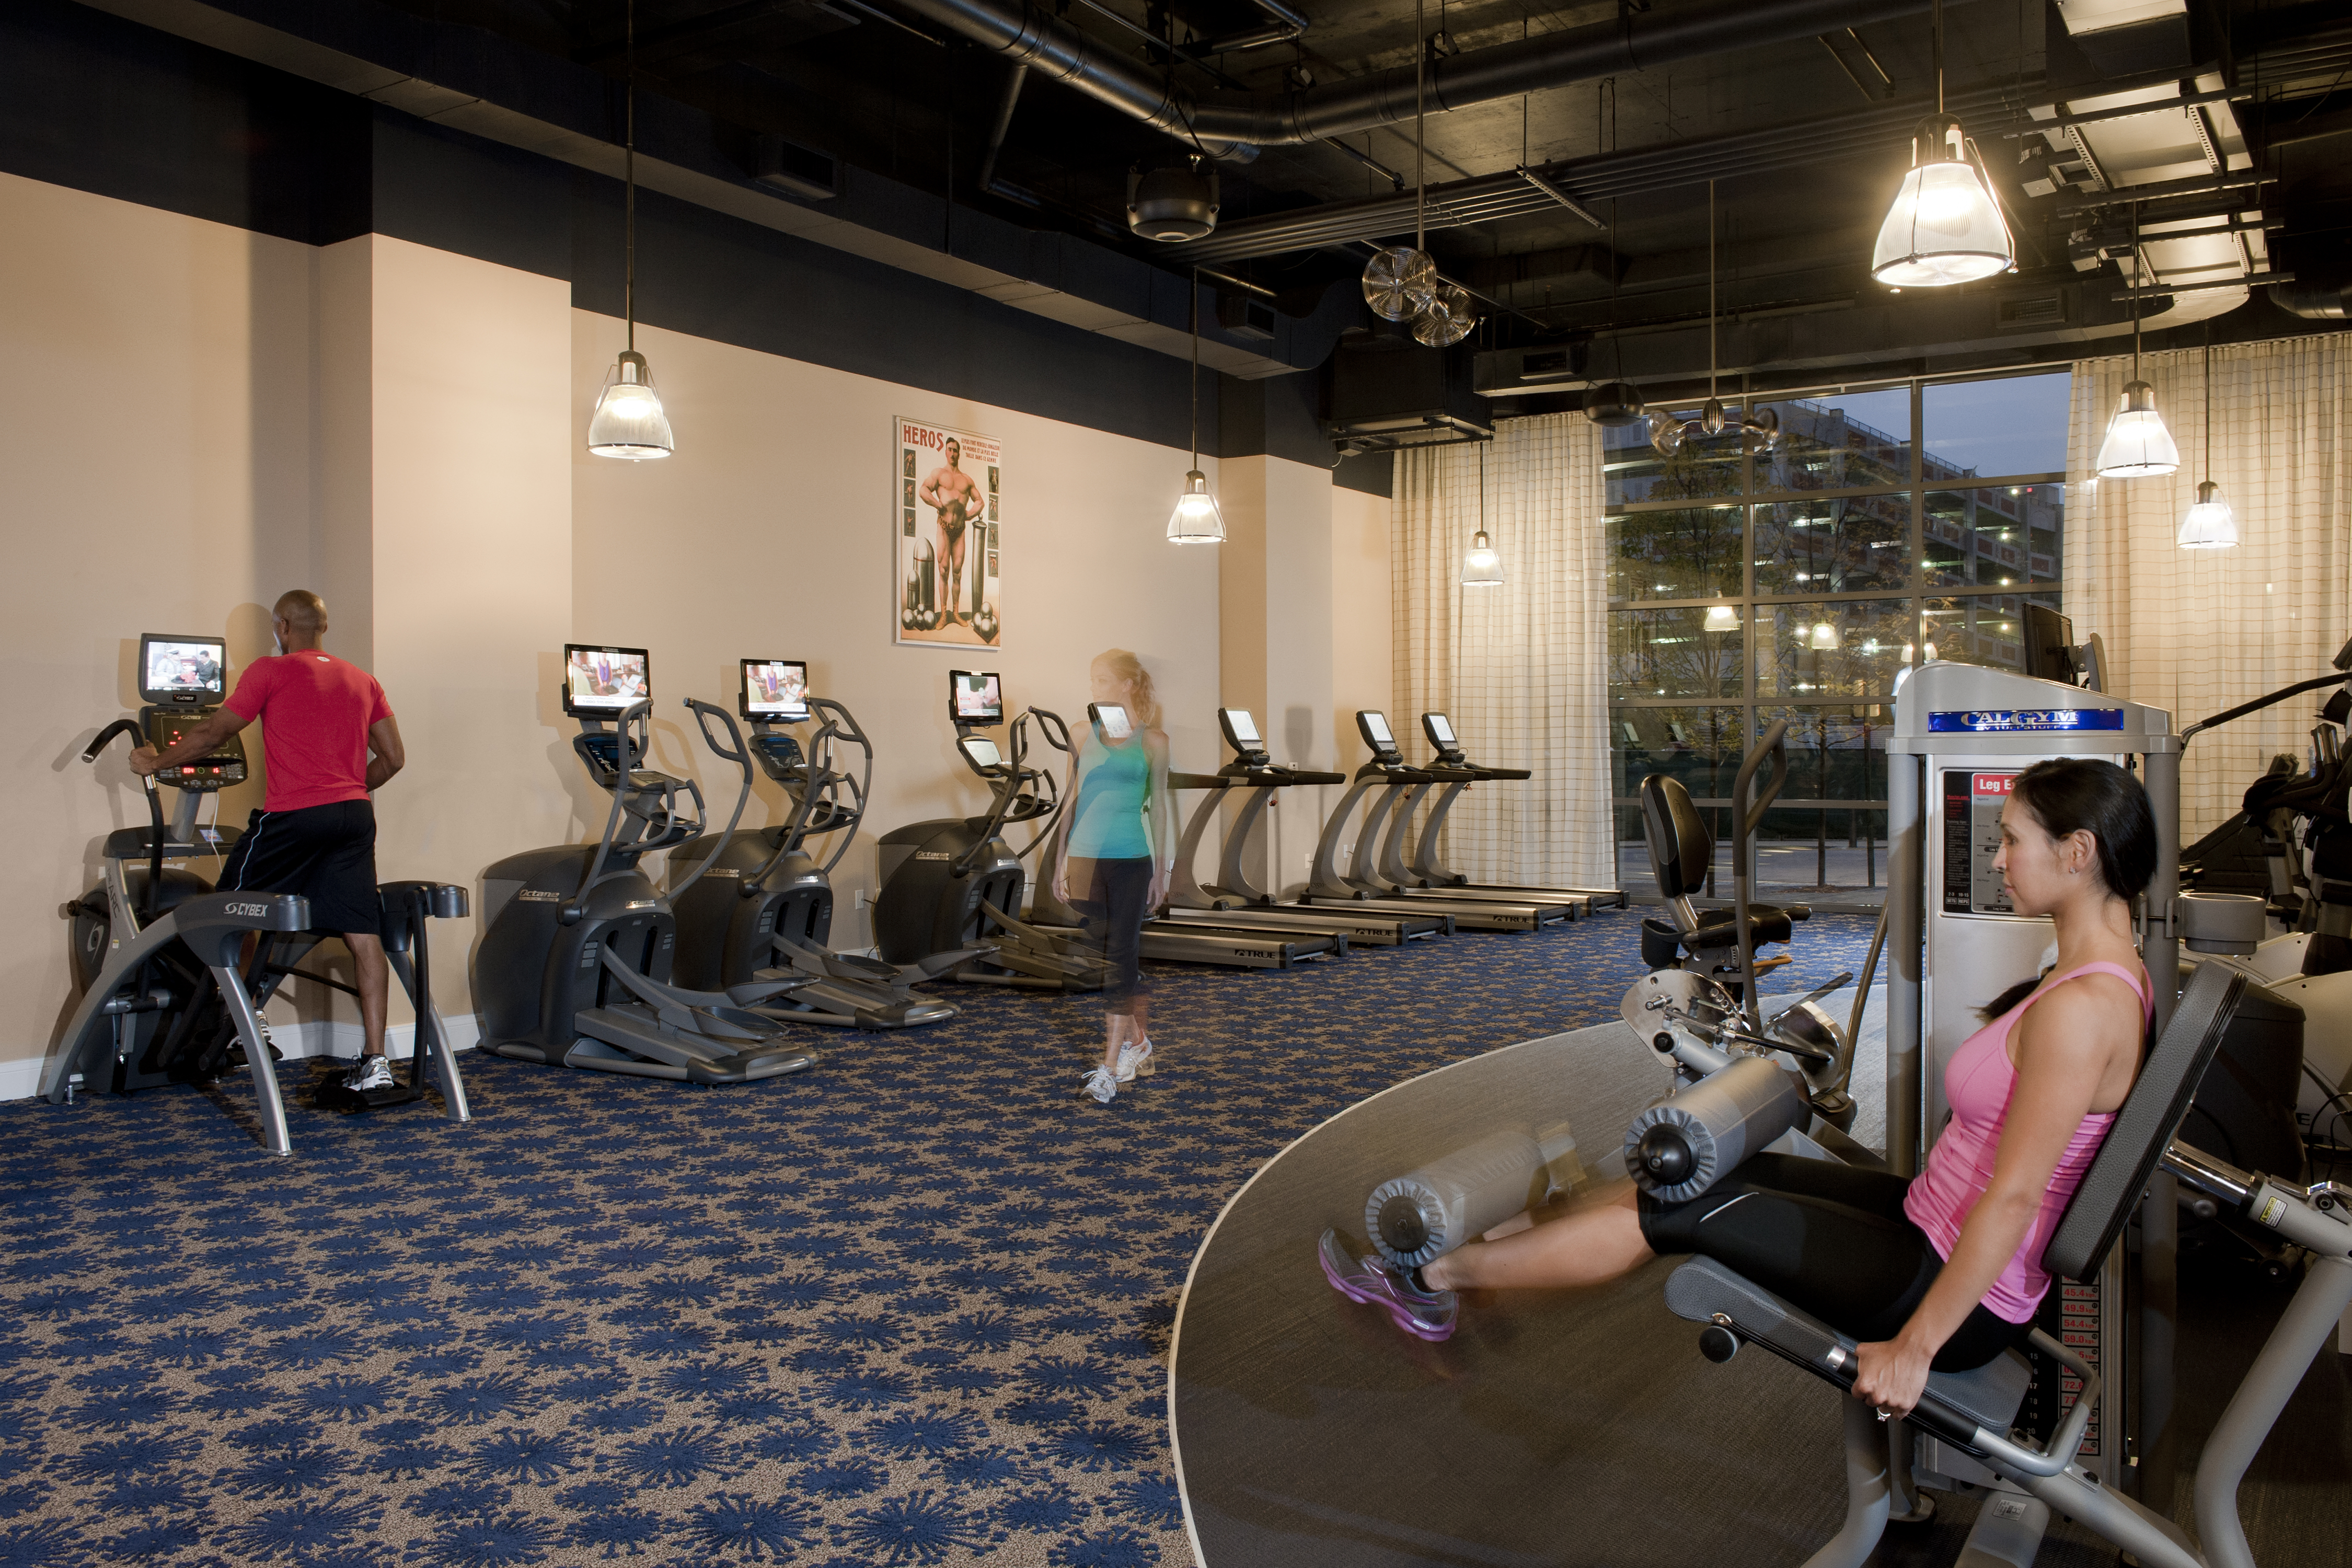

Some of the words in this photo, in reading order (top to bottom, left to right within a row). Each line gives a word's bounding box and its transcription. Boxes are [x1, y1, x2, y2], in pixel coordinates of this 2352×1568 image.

[904, 424, 944, 452] HEROS
[1980, 779, 2000, 792] Leg
[520, 889, 560, 897] Octane
[108, 885, 120, 918] ARC
[237, 903, 268, 917] CYBEX
[1246, 950, 1275, 959] TRUE
[2065, 1288, 2084, 1297] 45.4
[2065, 1304, 2085, 1312] 49.9
[2065, 1319, 2084, 1328] 54.4
[2065, 1335, 2084, 1343] 59.0
